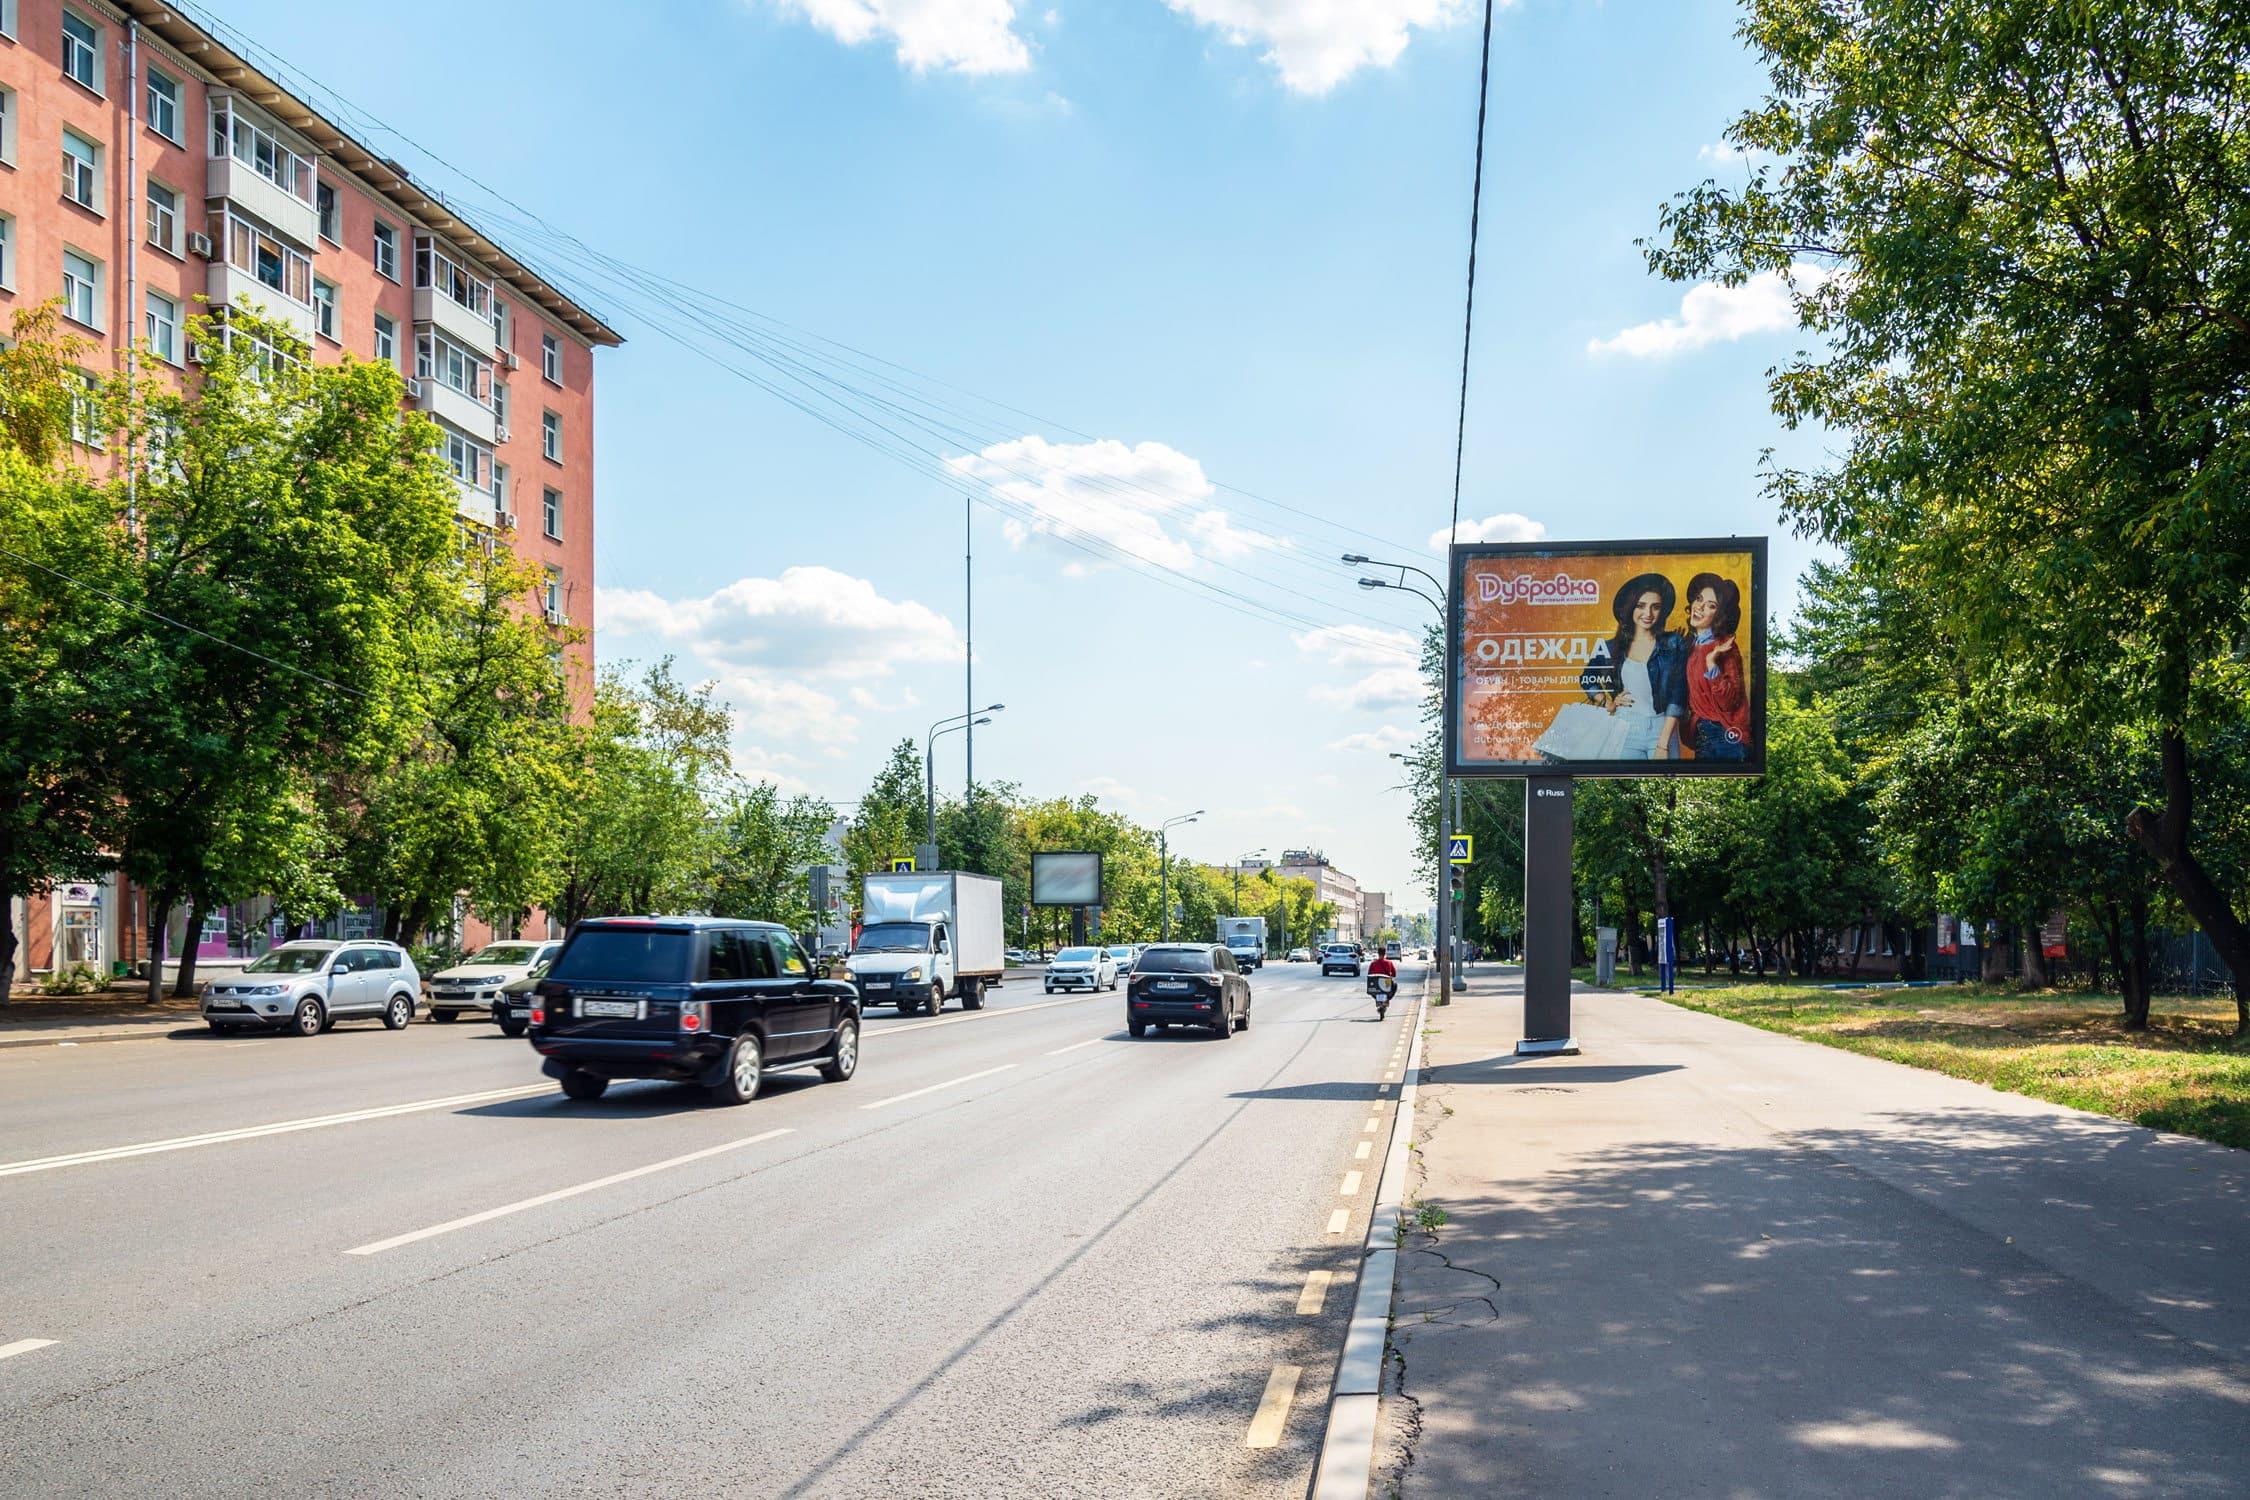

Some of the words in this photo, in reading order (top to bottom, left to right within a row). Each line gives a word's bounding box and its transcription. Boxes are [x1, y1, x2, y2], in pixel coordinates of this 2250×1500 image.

[1477, 574, 1598, 604] Дубровка
[1476, 637, 1612, 665] ОДЕЖДА
[1520, 675, 1558, 685] ТОВАРЫ
[1560, 675, 1580, 685] ДЛЯ
[1581, 675, 1613, 685] ДОМА
[1545, 789, 1566, 797] Russ
